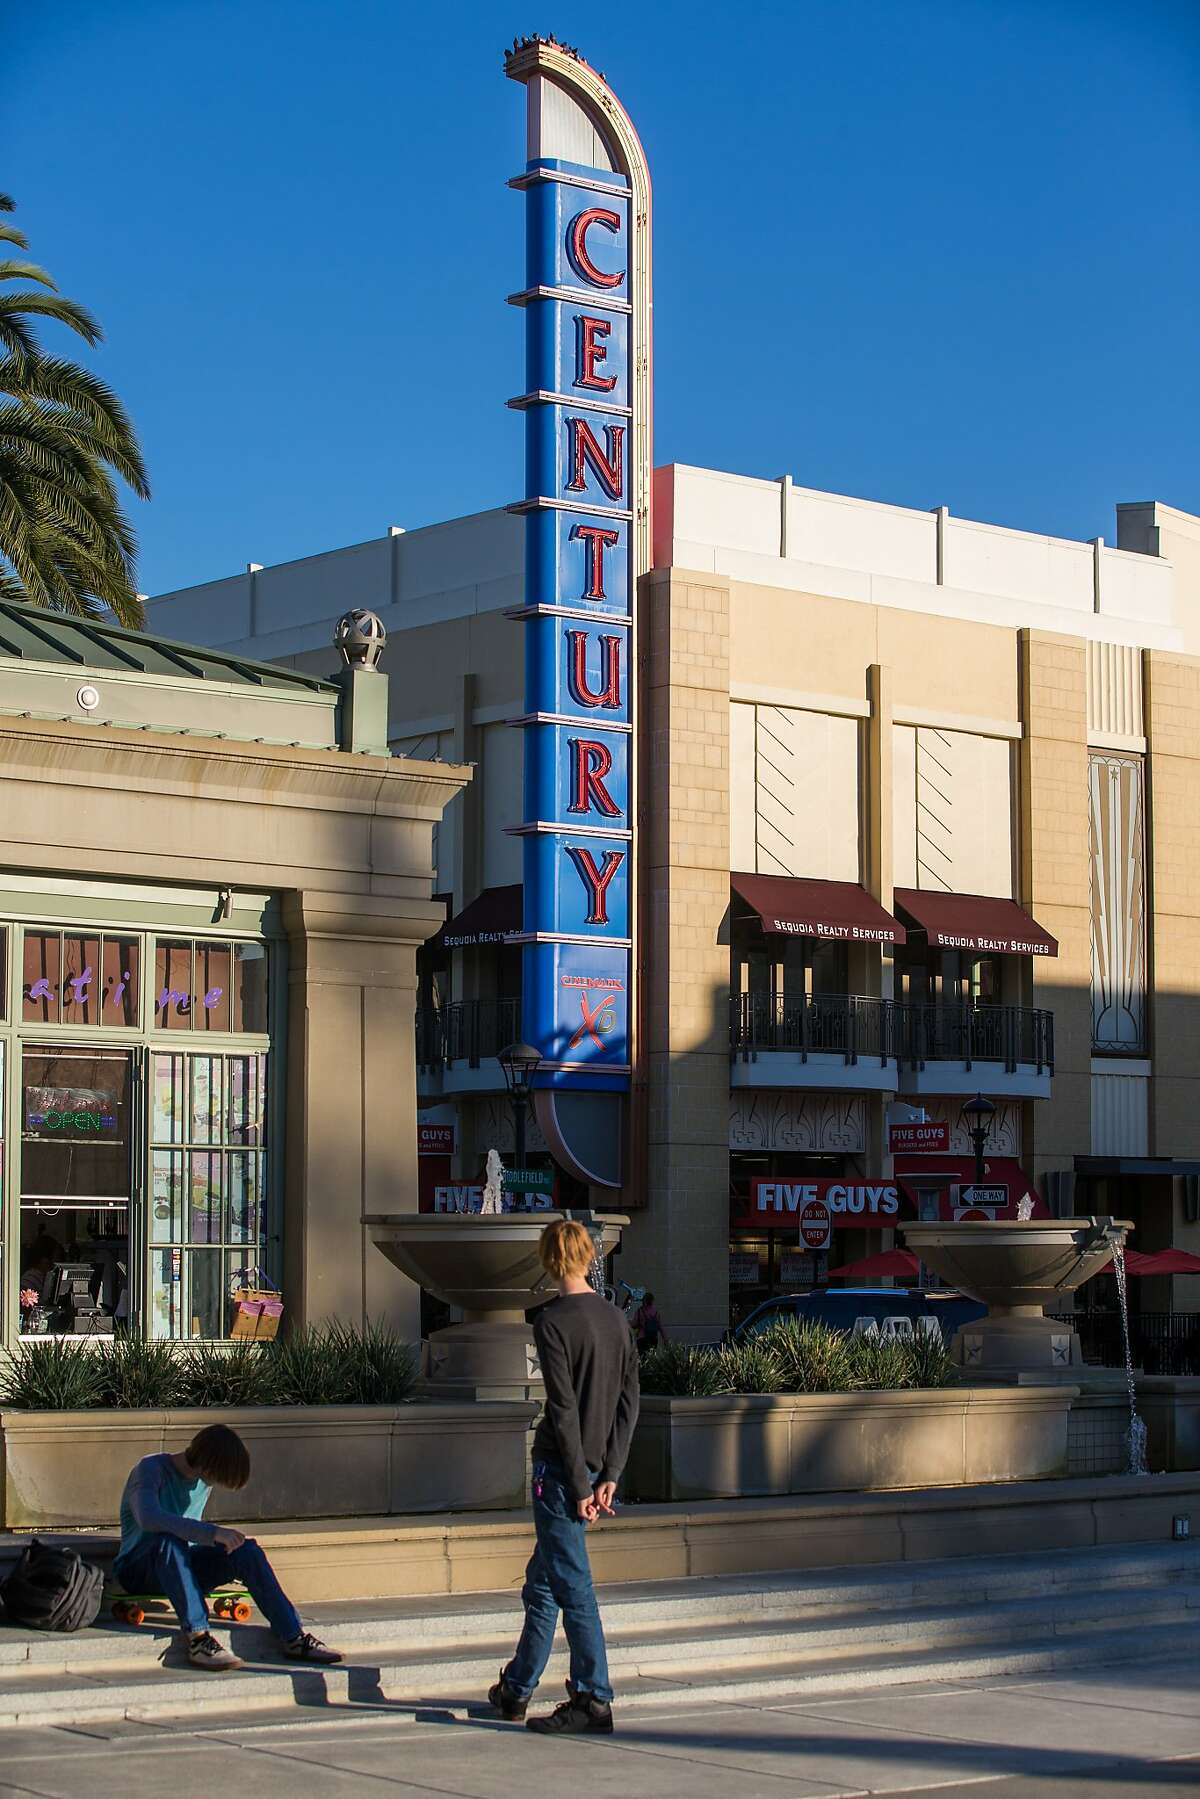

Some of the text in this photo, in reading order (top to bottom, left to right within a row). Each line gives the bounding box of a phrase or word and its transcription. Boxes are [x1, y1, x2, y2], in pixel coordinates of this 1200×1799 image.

[565, 207, 626, 925] CENTURY
[774, 920, 894, 940] SEQUOIA REALTY SERVICES
[938, 933, 1049, 954] SEQUOIA REALTY SERVICES
[46, 1111, 101, 1130] OPEN
[421, 1130, 451, 1140] GUYS
[892, 1128, 944, 1140] FIVE GUYS
[435, 1186, 482, 1213] FIVE
[757, 1184, 899, 1213] FIVE GUYS
[973, 1192, 1003, 1200] ONE WAY
[805, 1209, 827, 1217] DO NOT
[807, 1231, 824, 1239] ENTER
